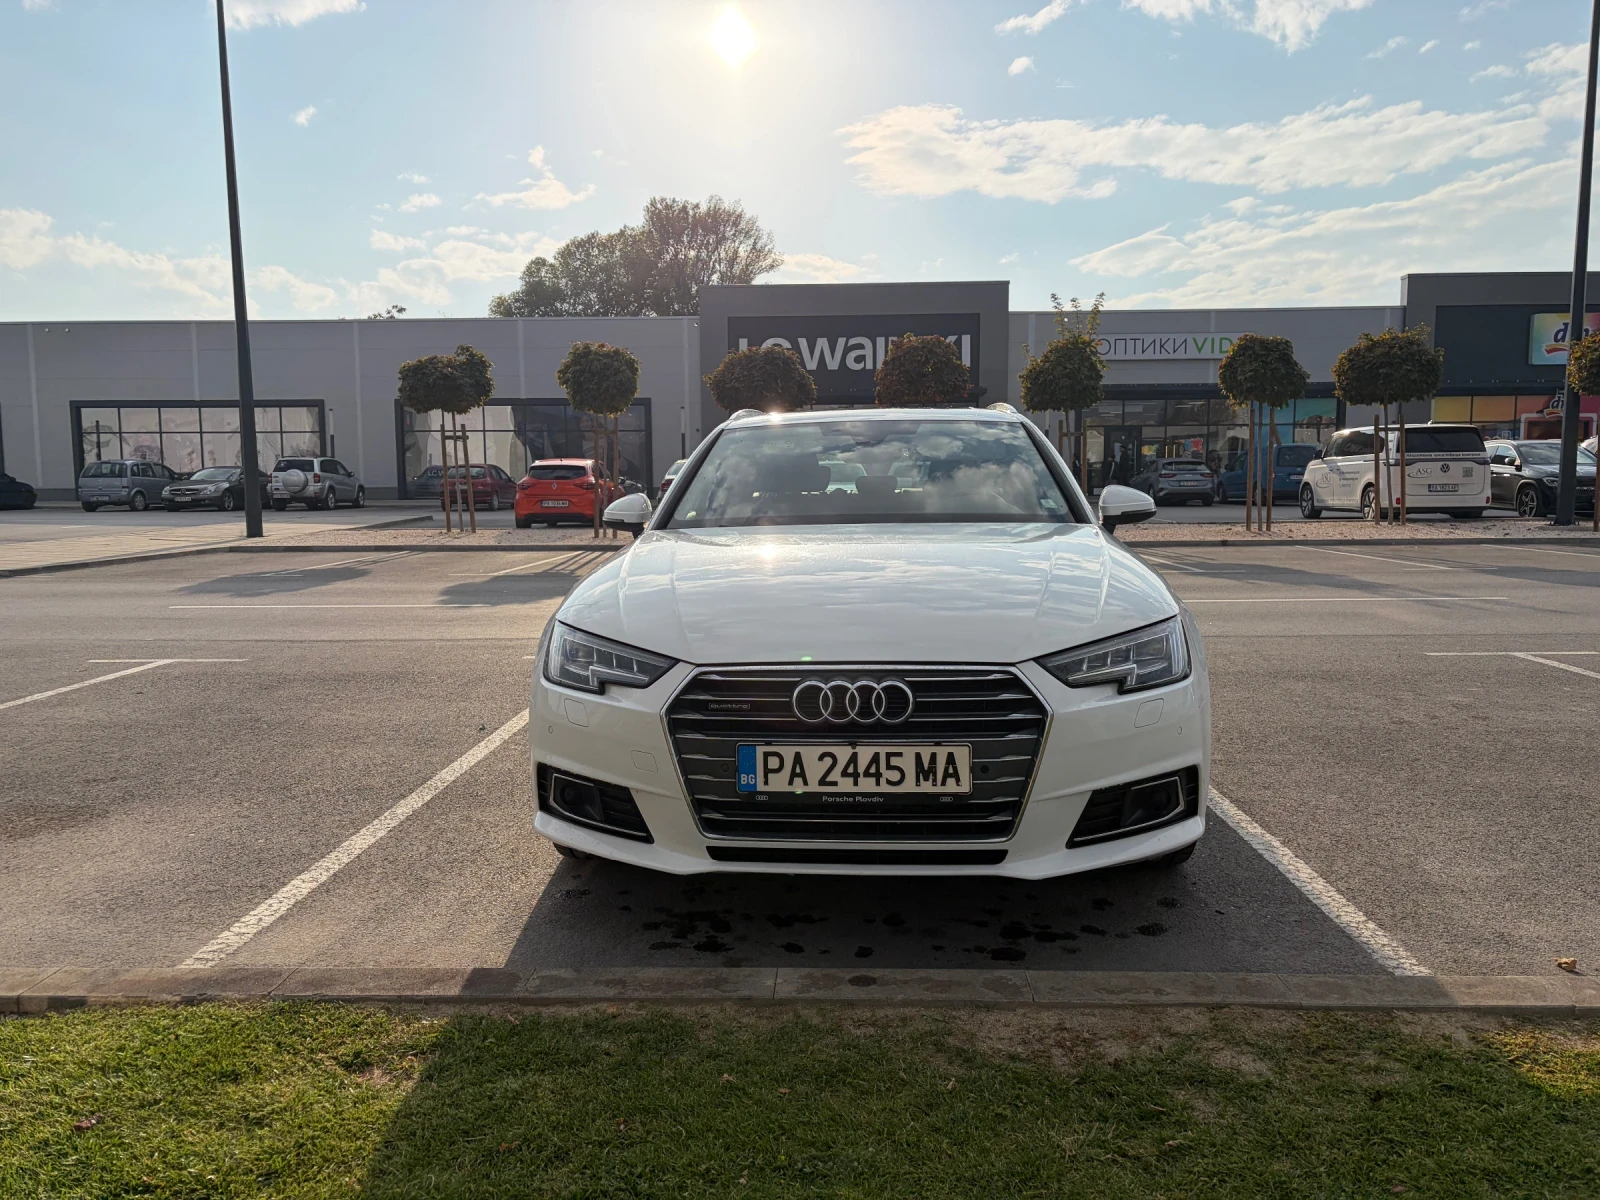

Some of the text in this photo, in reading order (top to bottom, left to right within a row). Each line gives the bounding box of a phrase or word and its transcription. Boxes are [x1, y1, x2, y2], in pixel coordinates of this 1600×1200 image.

[1096, 337, 1187, 356] ОПТИКИ
[1416, 467, 1432, 475] ASG
[762, 751, 962, 787] PA 2445 MA
[740, 773, 756, 785] BG
